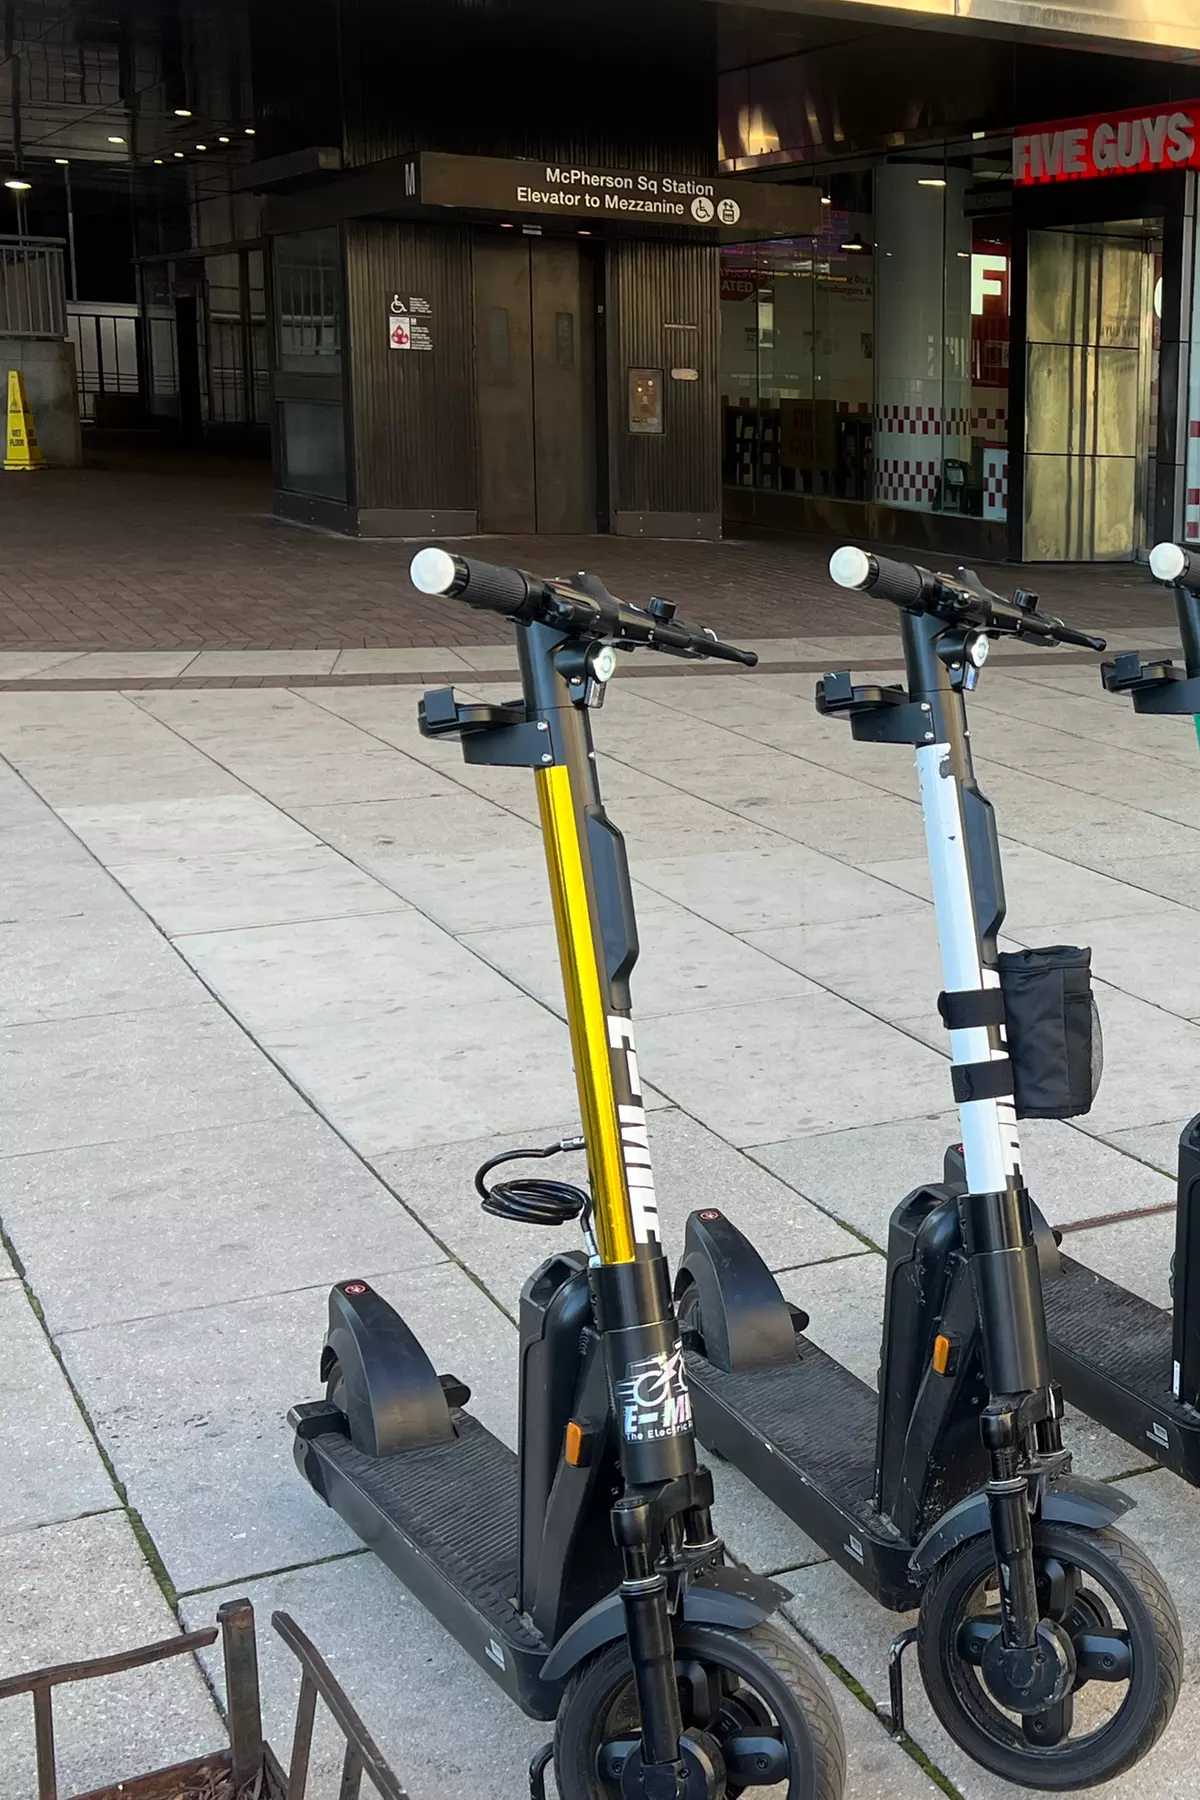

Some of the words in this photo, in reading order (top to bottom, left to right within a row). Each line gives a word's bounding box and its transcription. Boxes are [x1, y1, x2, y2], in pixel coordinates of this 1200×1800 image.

[1012, 128, 1088, 180] FIVE
[1092, 112, 1195, 171] GUYS
[405, 162, 416, 196] M
[545, 167, 633, 190] McPherson
[637, 174, 658, 194] Sq
[662, 177, 714, 197] Station
[517, 187, 580, 208] Elevator
[584, 193, 600, 208] to
[604, 193, 685, 215] Mezzanine
[721, 280, 753, 293] ATED
[971, 253, 1011, 316] F
[625, 1432, 643, 1441] The
[647, 1423, 688, 1439] Electric
